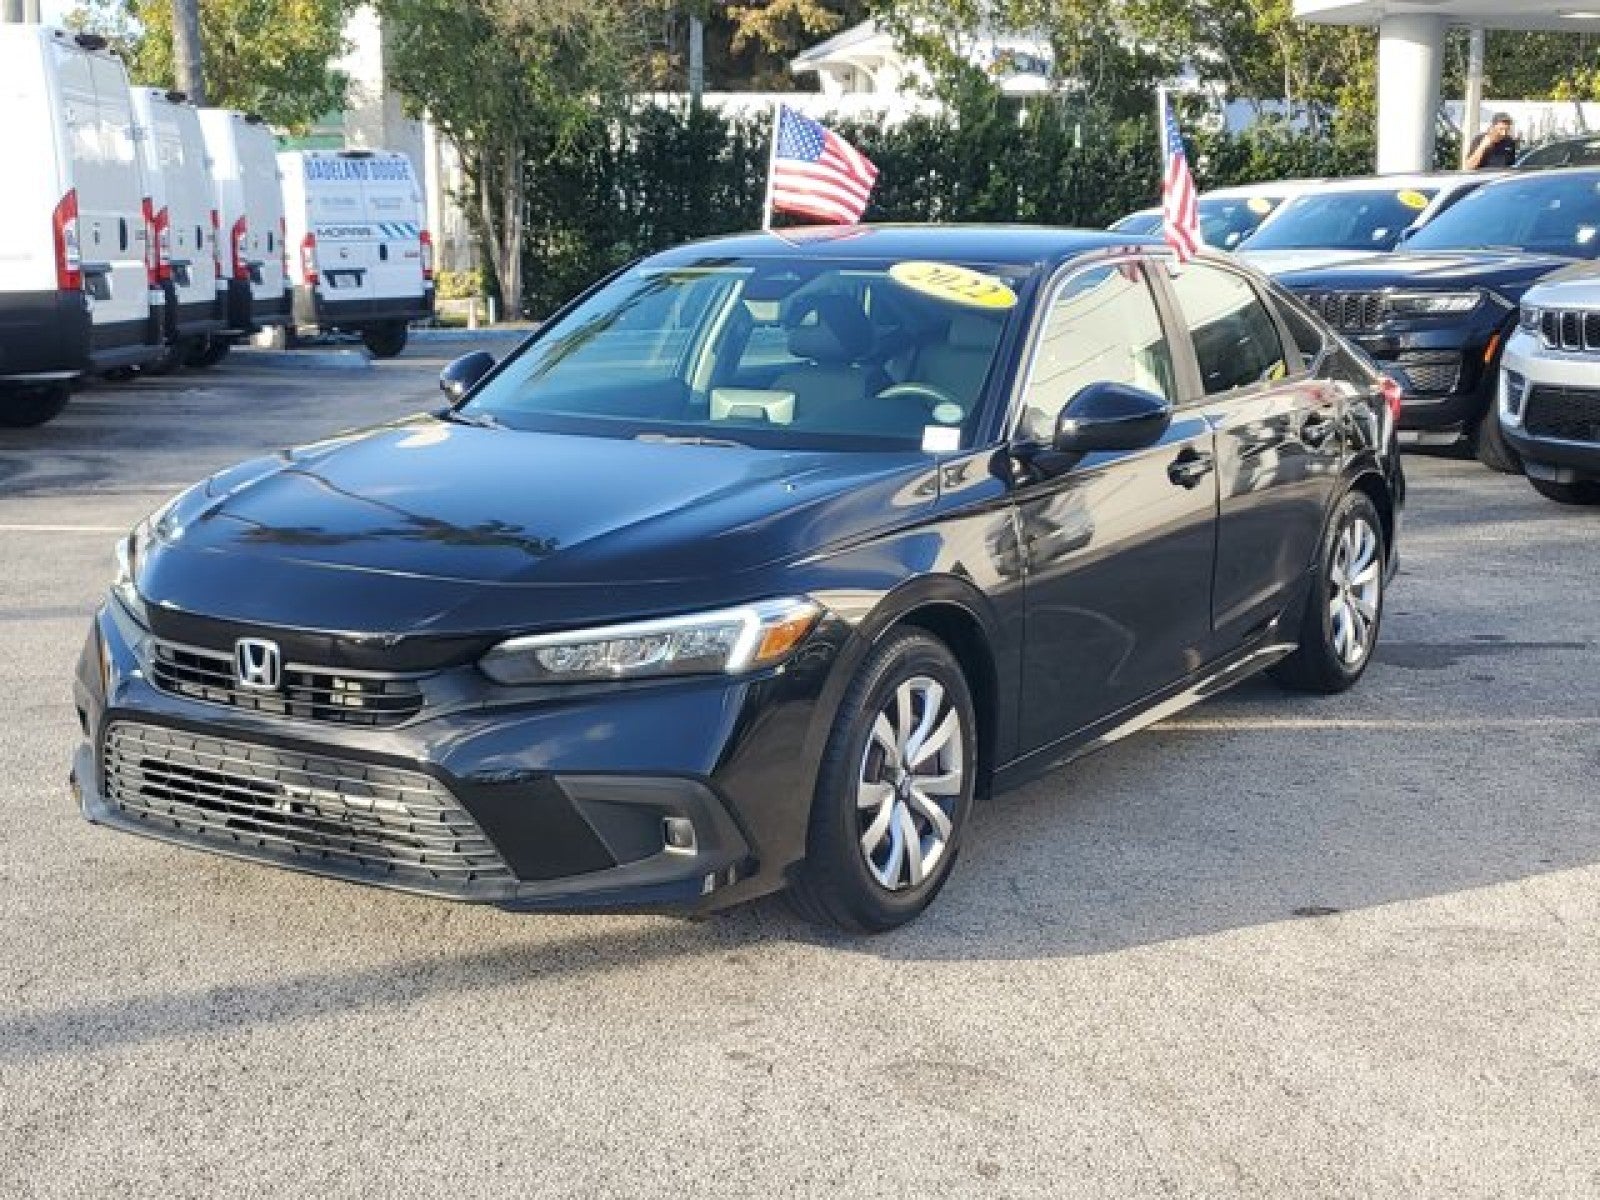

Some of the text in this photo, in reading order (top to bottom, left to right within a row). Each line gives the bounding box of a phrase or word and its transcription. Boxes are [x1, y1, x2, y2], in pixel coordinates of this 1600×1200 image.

[305, 159, 411, 181] DADELAND DODGE
[904, 263, 1003, 299] 2022
